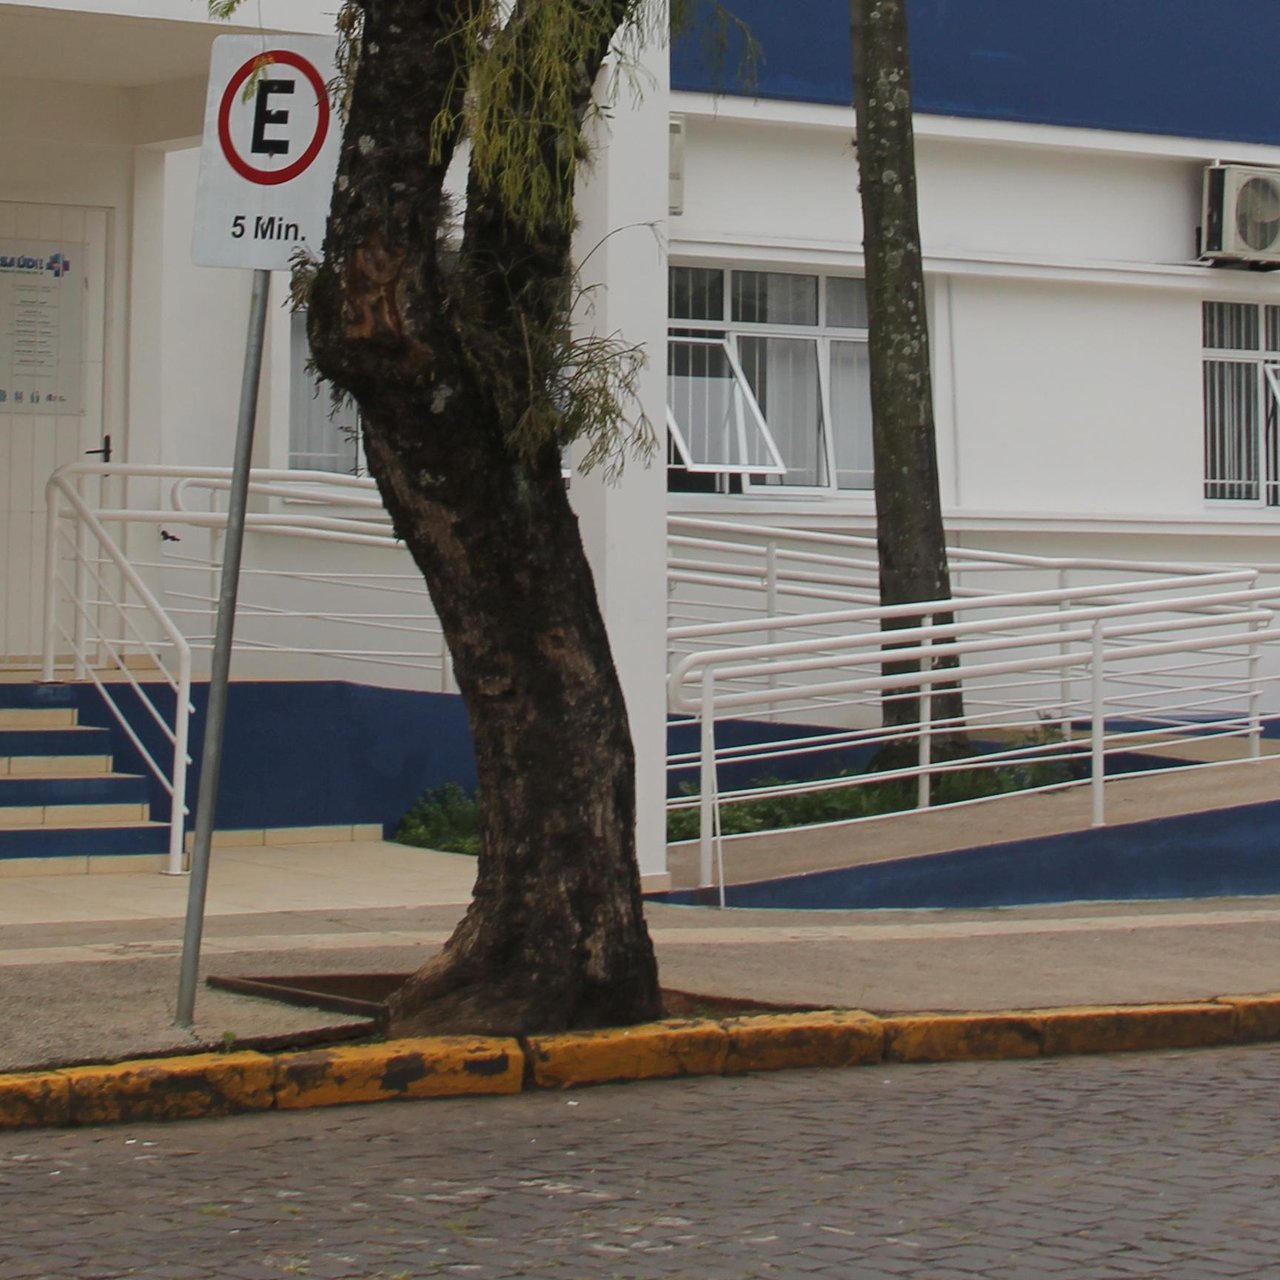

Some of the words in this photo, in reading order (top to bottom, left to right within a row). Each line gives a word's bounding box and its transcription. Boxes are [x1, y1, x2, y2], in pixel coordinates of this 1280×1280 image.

[251, 79, 296, 155] E
[231, 215, 246, 239] 5
[253, 215, 307, 241] Min.
